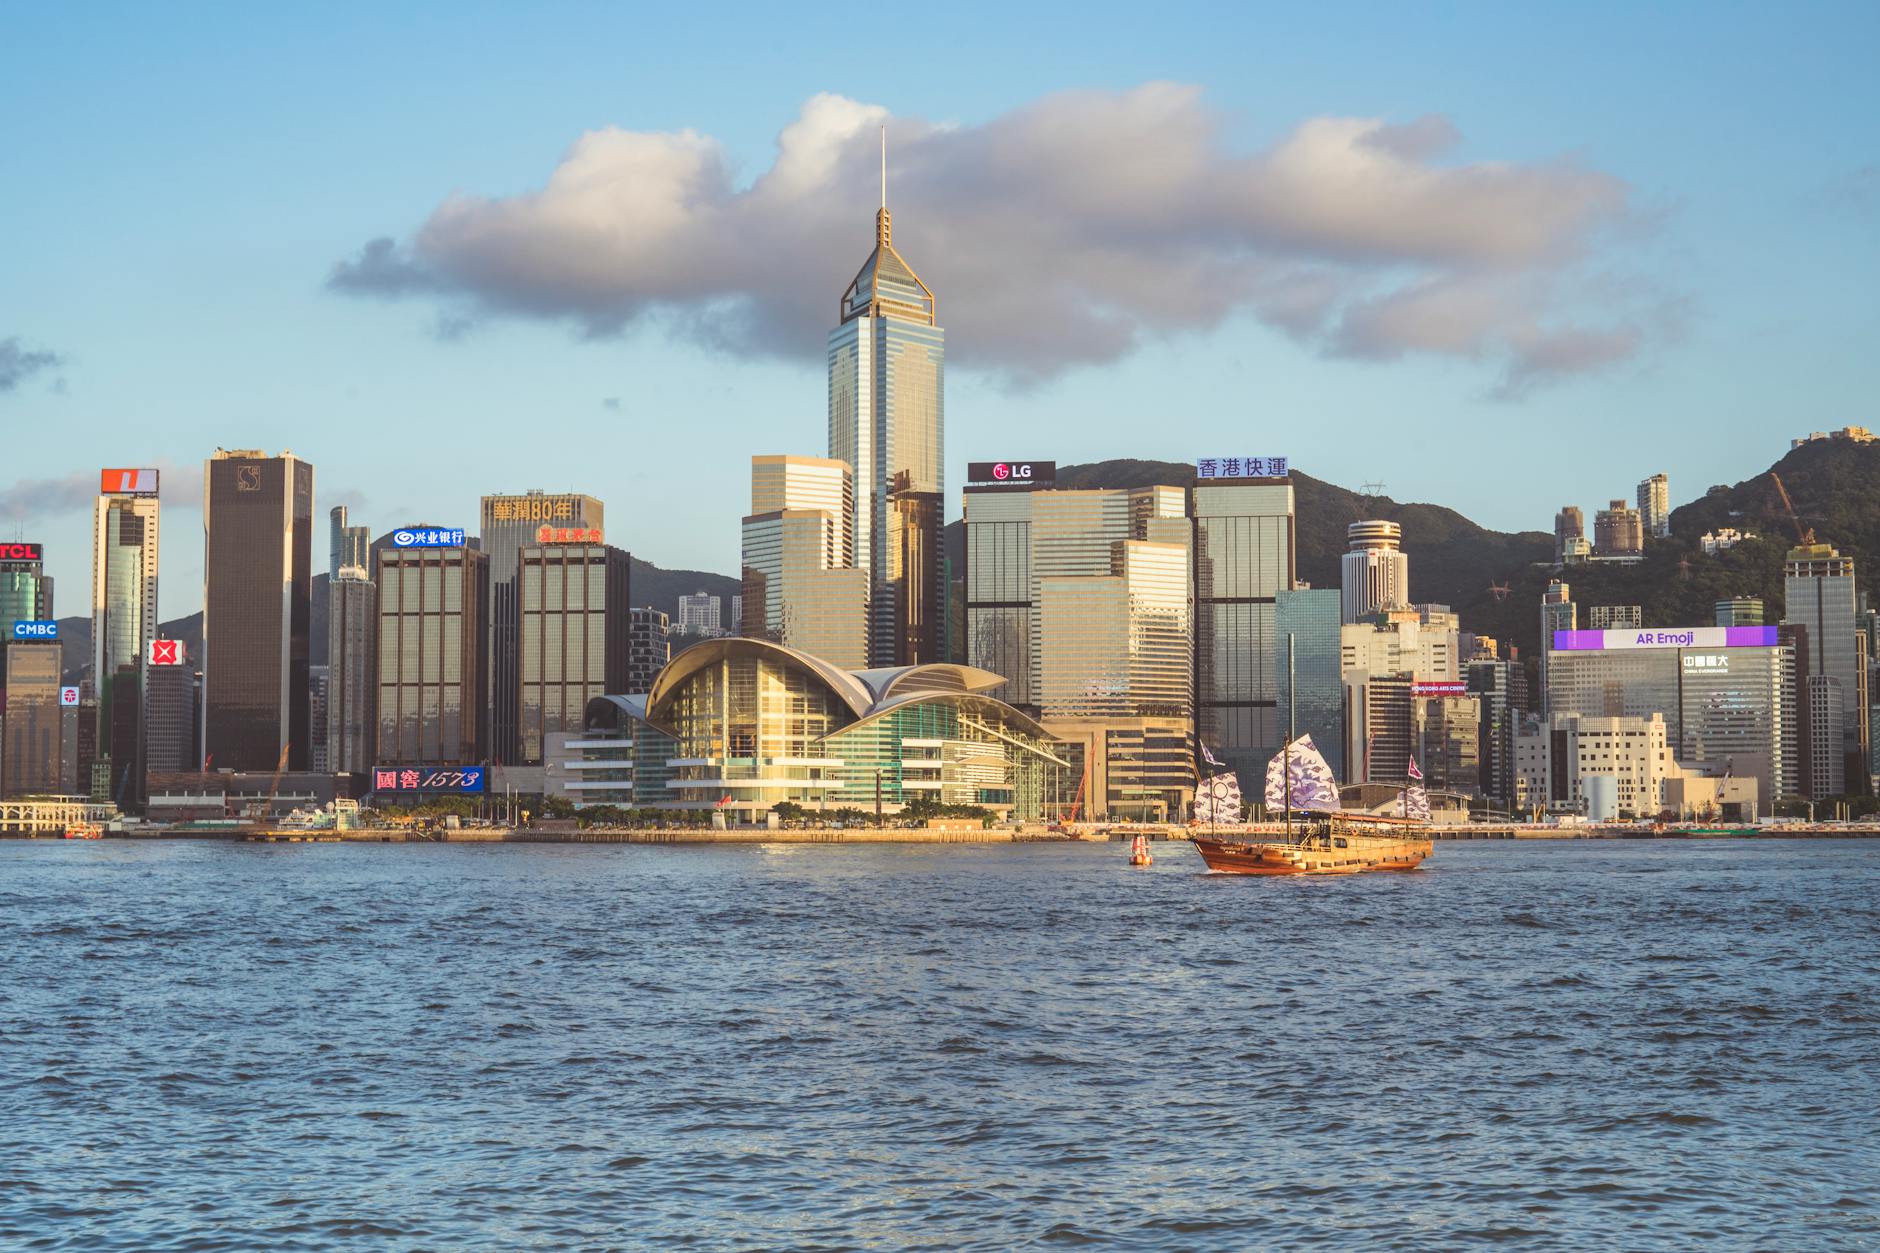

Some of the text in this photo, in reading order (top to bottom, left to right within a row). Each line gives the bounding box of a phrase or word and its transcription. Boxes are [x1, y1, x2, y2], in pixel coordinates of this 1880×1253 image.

[1012, 465, 1031, 477] LG
[1200, 458, 1286, 477] 香港快運
[494, 500, 571, 520] 華潤80年
[414, 531, 463, 543] 兴业银行
[0, 544, 38, 558] TCL
[16, 624, 56, 635] CMBC
[1636, 631, 1694, 646] AR Emoji
[377, 770, 479, 789] 國窖 1573
